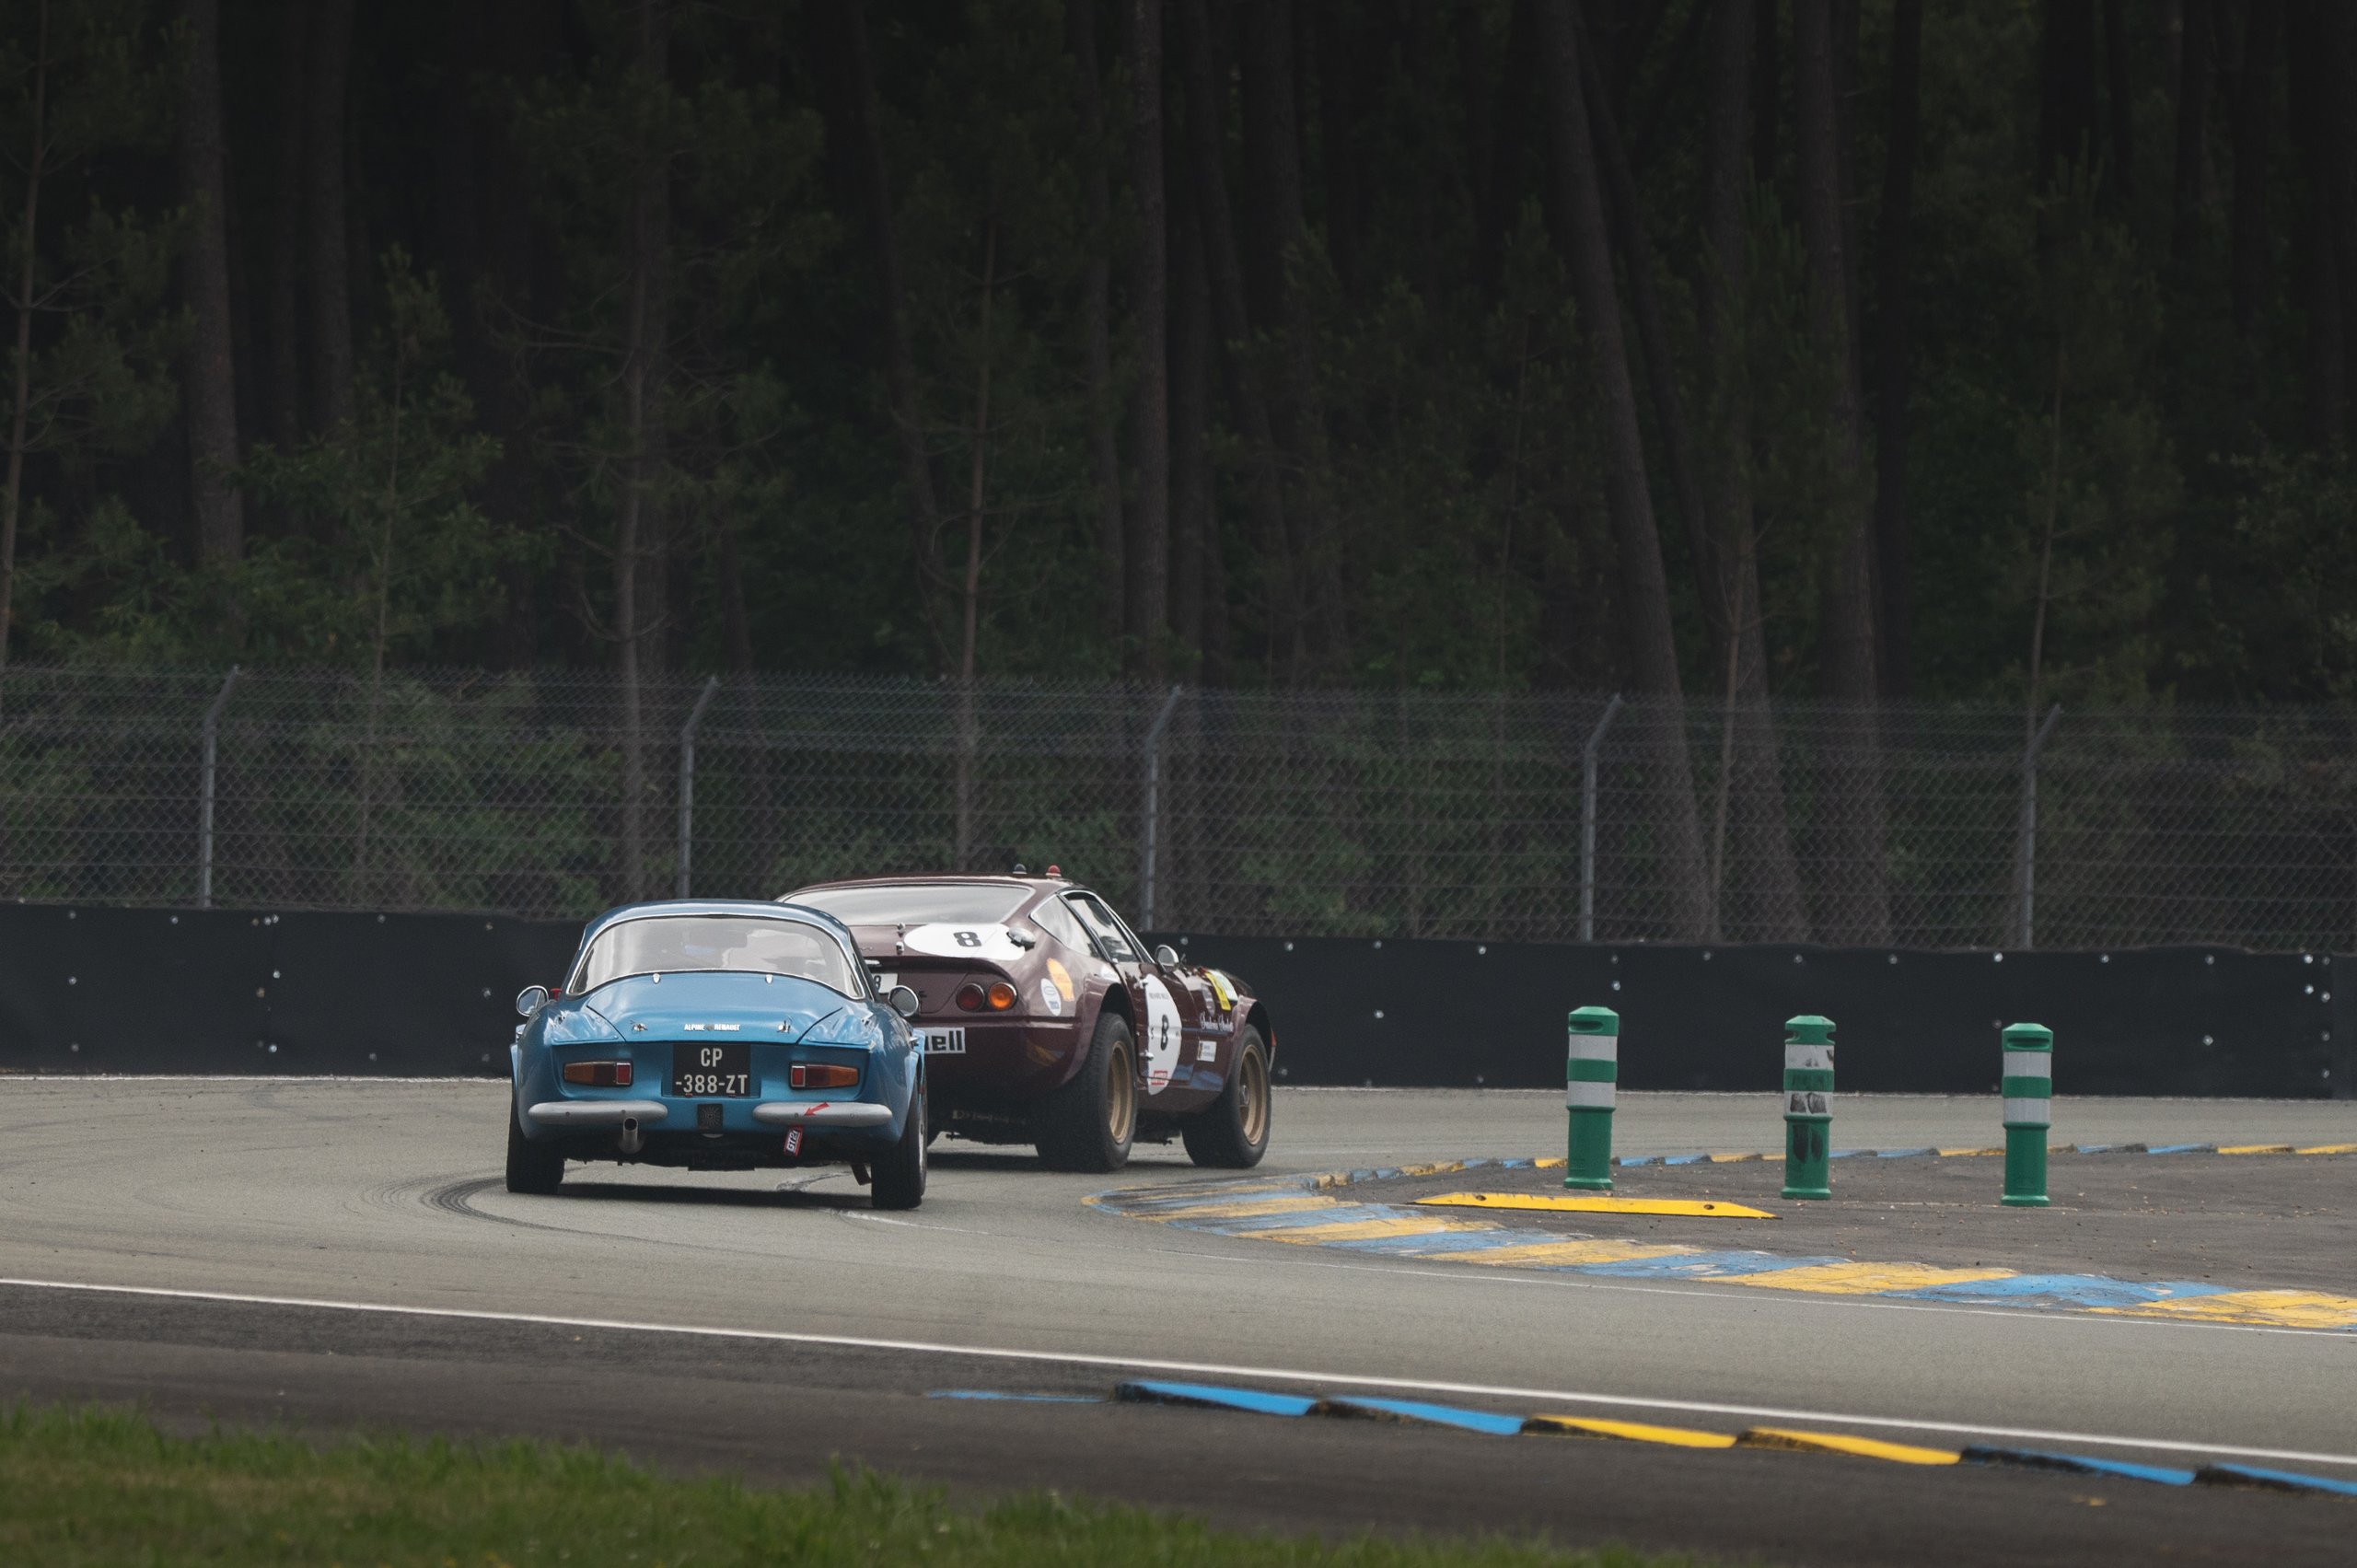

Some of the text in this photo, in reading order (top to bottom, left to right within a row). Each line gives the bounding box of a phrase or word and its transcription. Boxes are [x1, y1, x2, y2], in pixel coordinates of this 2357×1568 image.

[953, 931, 981, 947] 8
[684, 1023, 741, 1031] ALPINE RENAULT
[1161, 1014, 1168, 1051] 8
[923, 1029, 963, 1051] ell
[701, 1047, 723, 1067] CP
